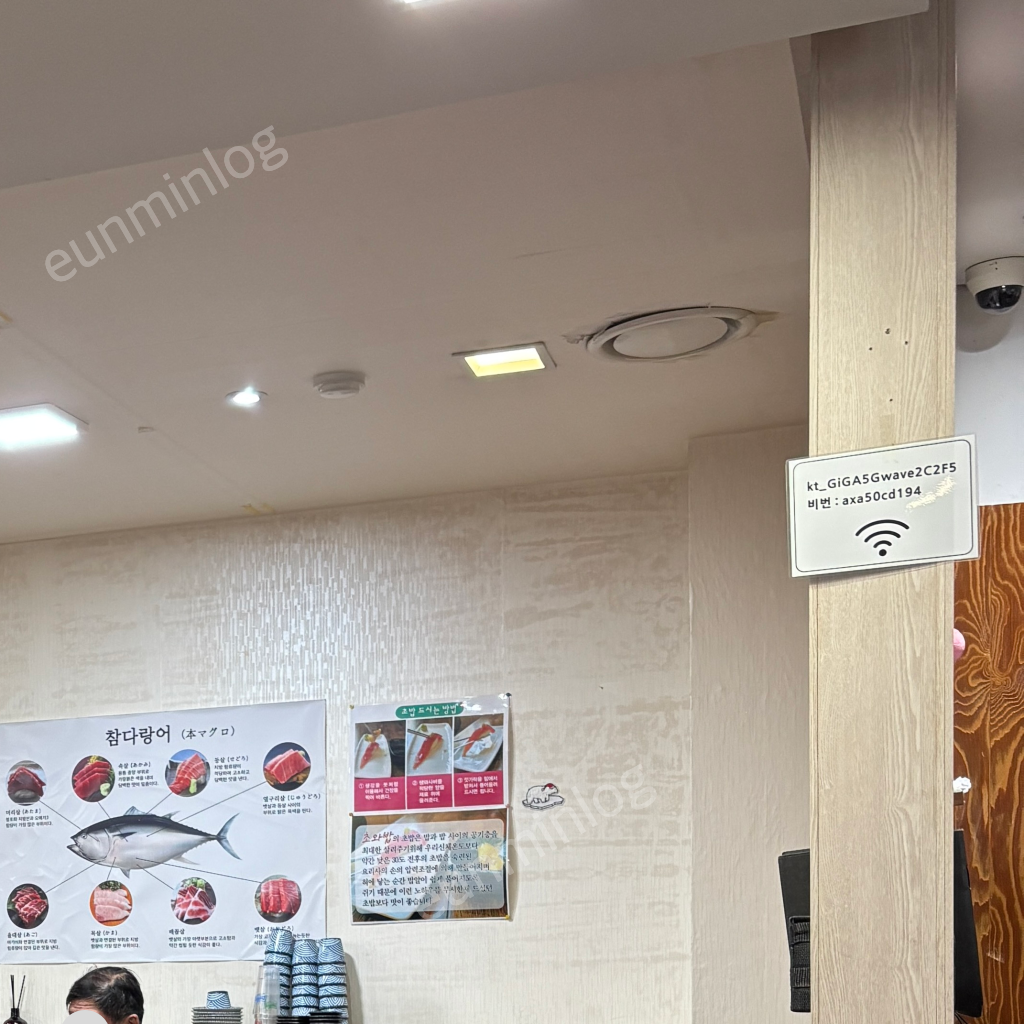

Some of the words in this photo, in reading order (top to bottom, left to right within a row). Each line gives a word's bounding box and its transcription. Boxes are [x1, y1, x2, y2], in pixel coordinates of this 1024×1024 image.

[807, 462, 957, 492] kt_GiGA5Gwave2C2F5
[402, 707, 415, 717] 초밥
[418, 705, 439, 715] 드시는
[442, 703, 457, 714] 방법
[105, 724, 171, 747] 참다랑어
[401, 834, 421, 842] 초밥은
[439, 832, 446, 840] 밥
[448, 831, 468, 841] 사이의
[377, 887, 397, 897] 때문에
[362, 898, 389, 908] 초밥보다
[390, 897, 404, 907] 맛이
